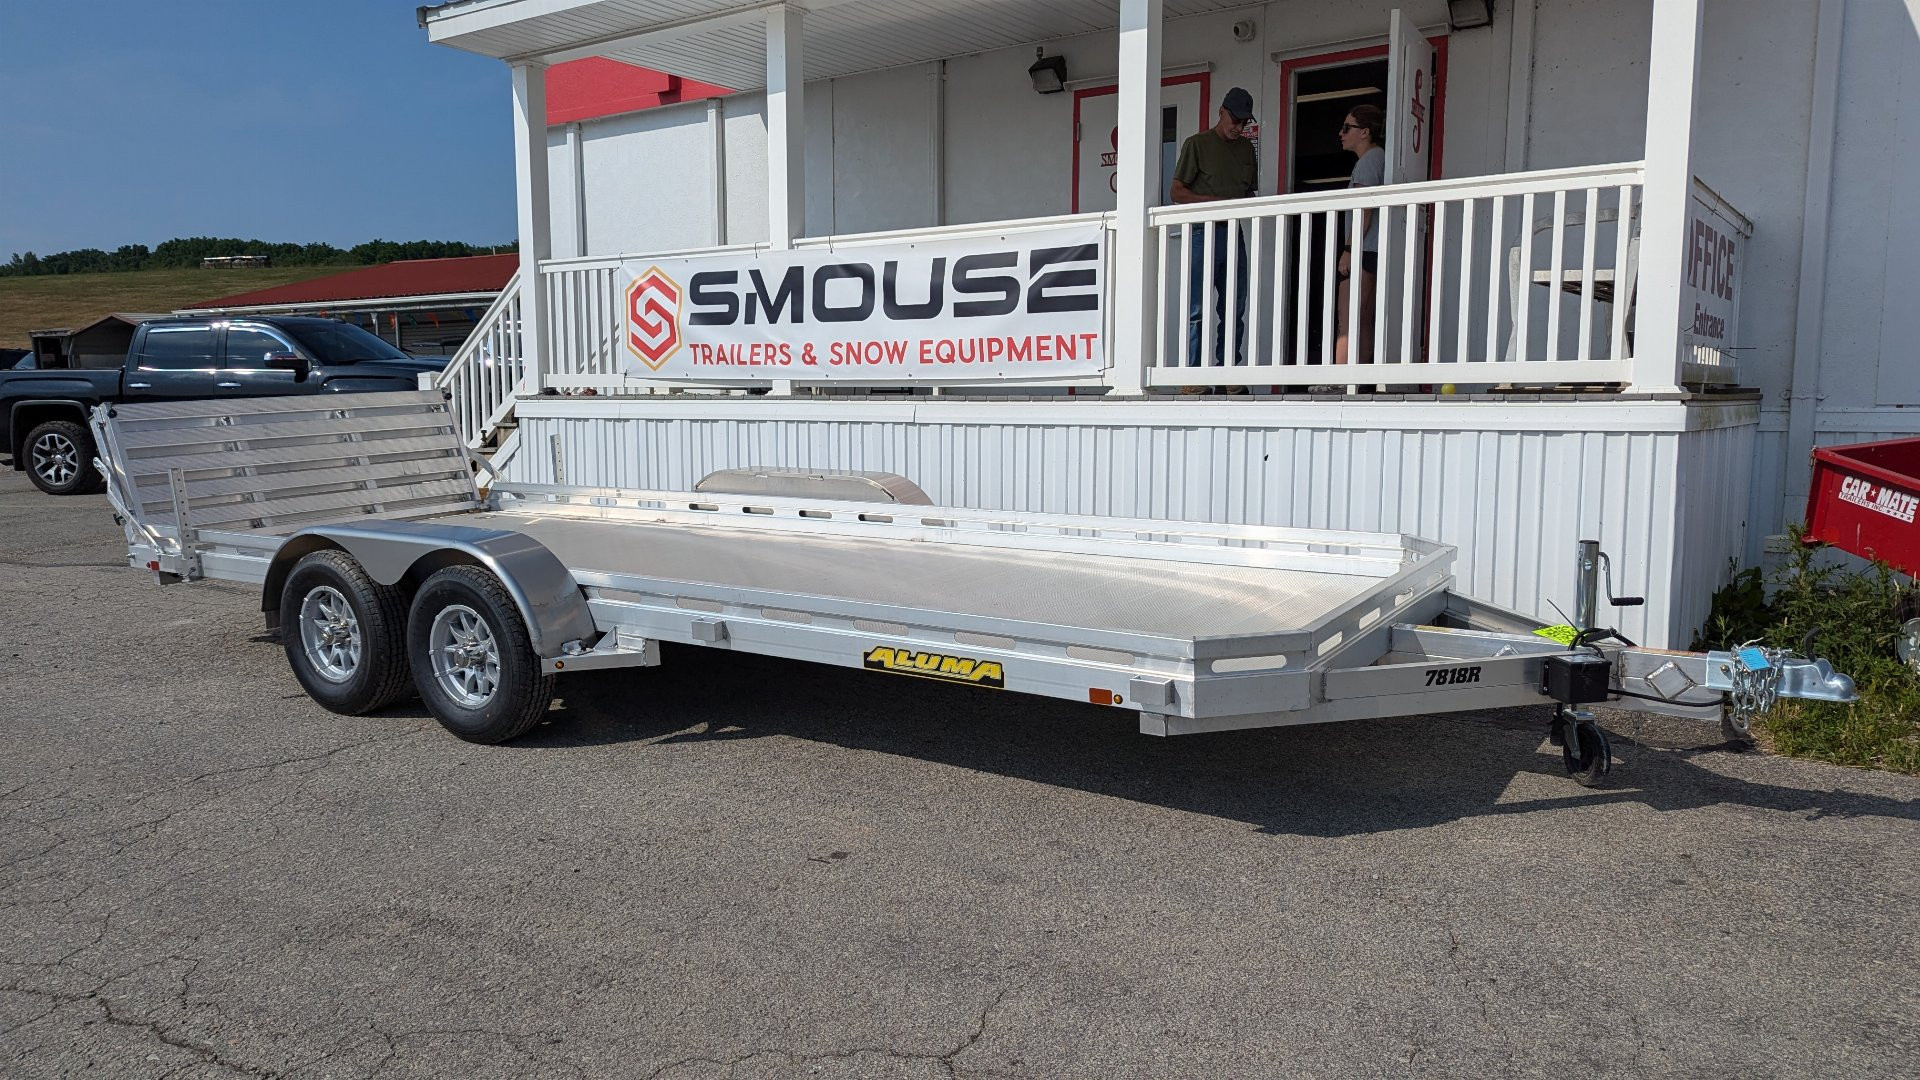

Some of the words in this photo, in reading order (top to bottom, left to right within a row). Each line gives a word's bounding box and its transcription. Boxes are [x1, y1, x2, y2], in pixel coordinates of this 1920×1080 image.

[688, 243, 1099, 326] SMOUSE
[1693, 302, 1725, 340] Entrance
[689, 341, 791, 366] TRAILERS
[801, 342, 818, 365] &
[829, 340, 908, 366] SNOW
[919, 333, 1098, 365] EQUIPMENT
[866, 646, 1002, 681] ALUMA
[1425, 665, 1482, 687] 7818R
